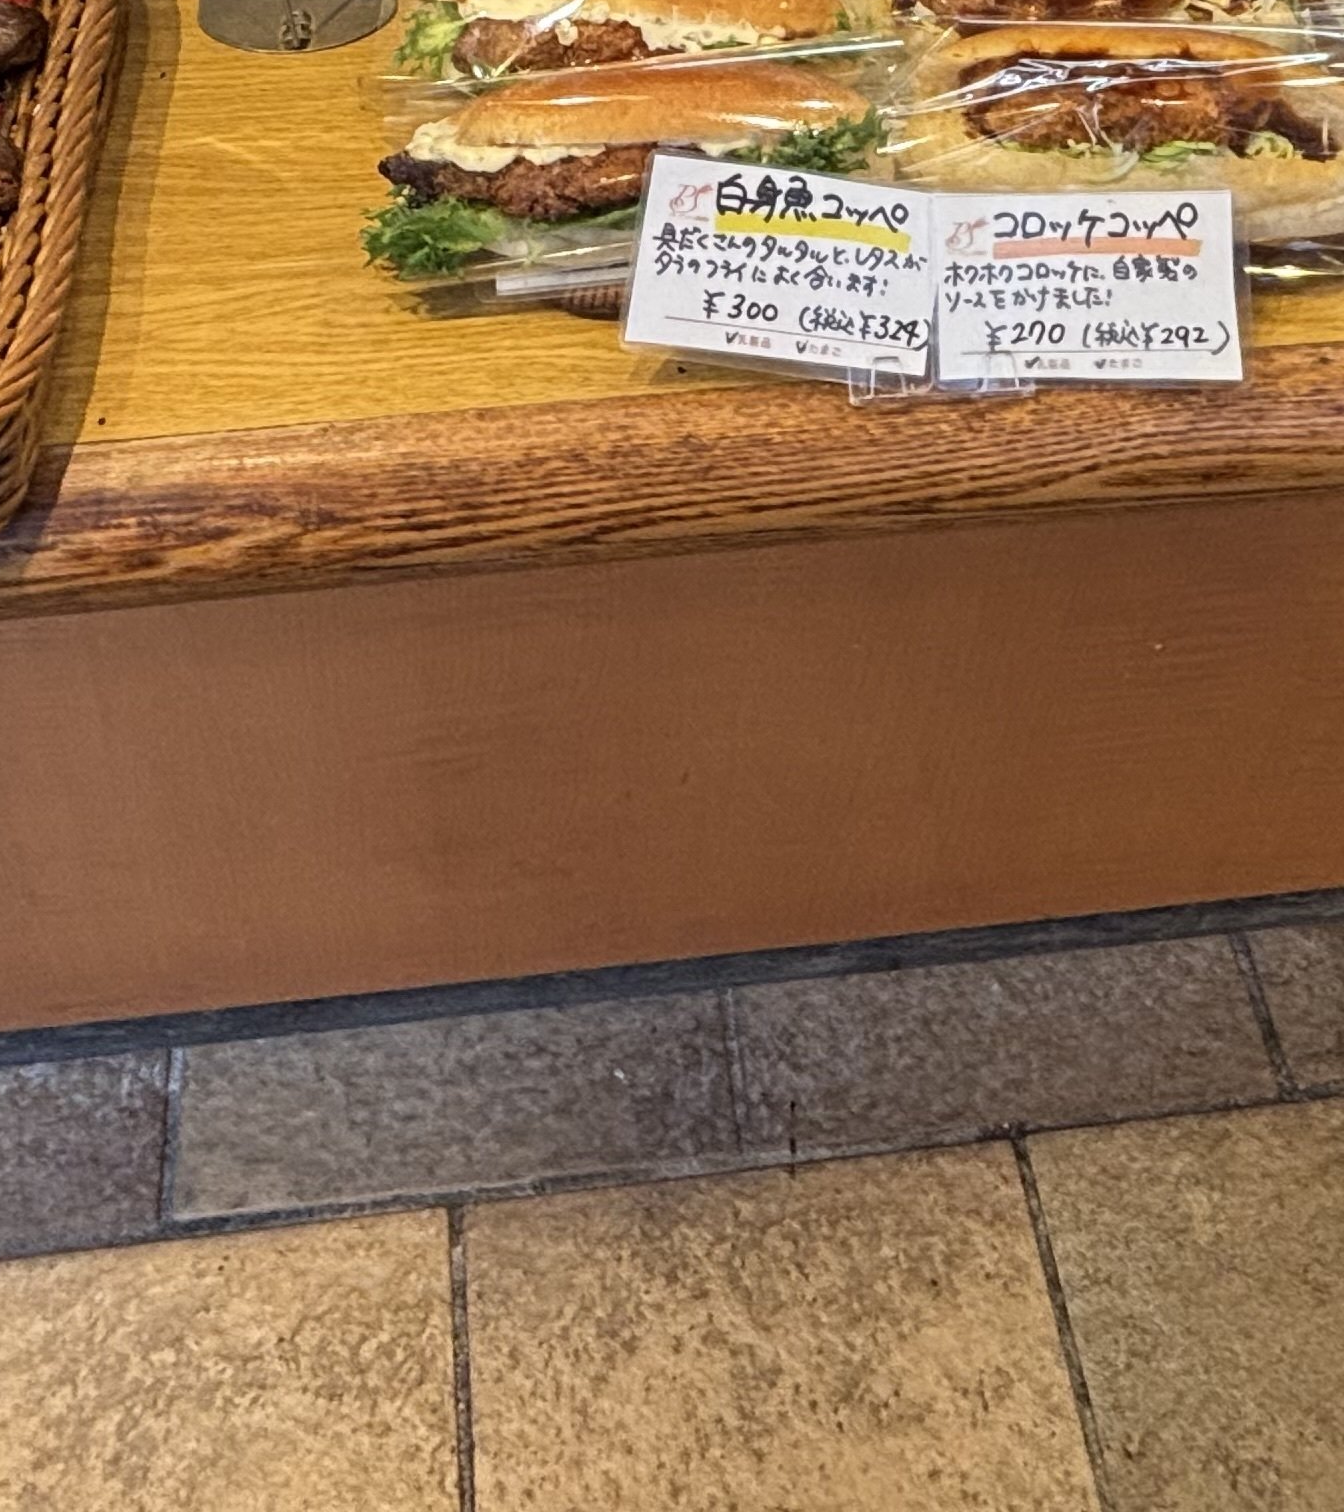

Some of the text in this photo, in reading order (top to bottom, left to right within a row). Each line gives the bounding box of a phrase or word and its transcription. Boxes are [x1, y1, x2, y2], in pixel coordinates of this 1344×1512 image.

[992, 201, 1199, 249] コロッケコッペ
